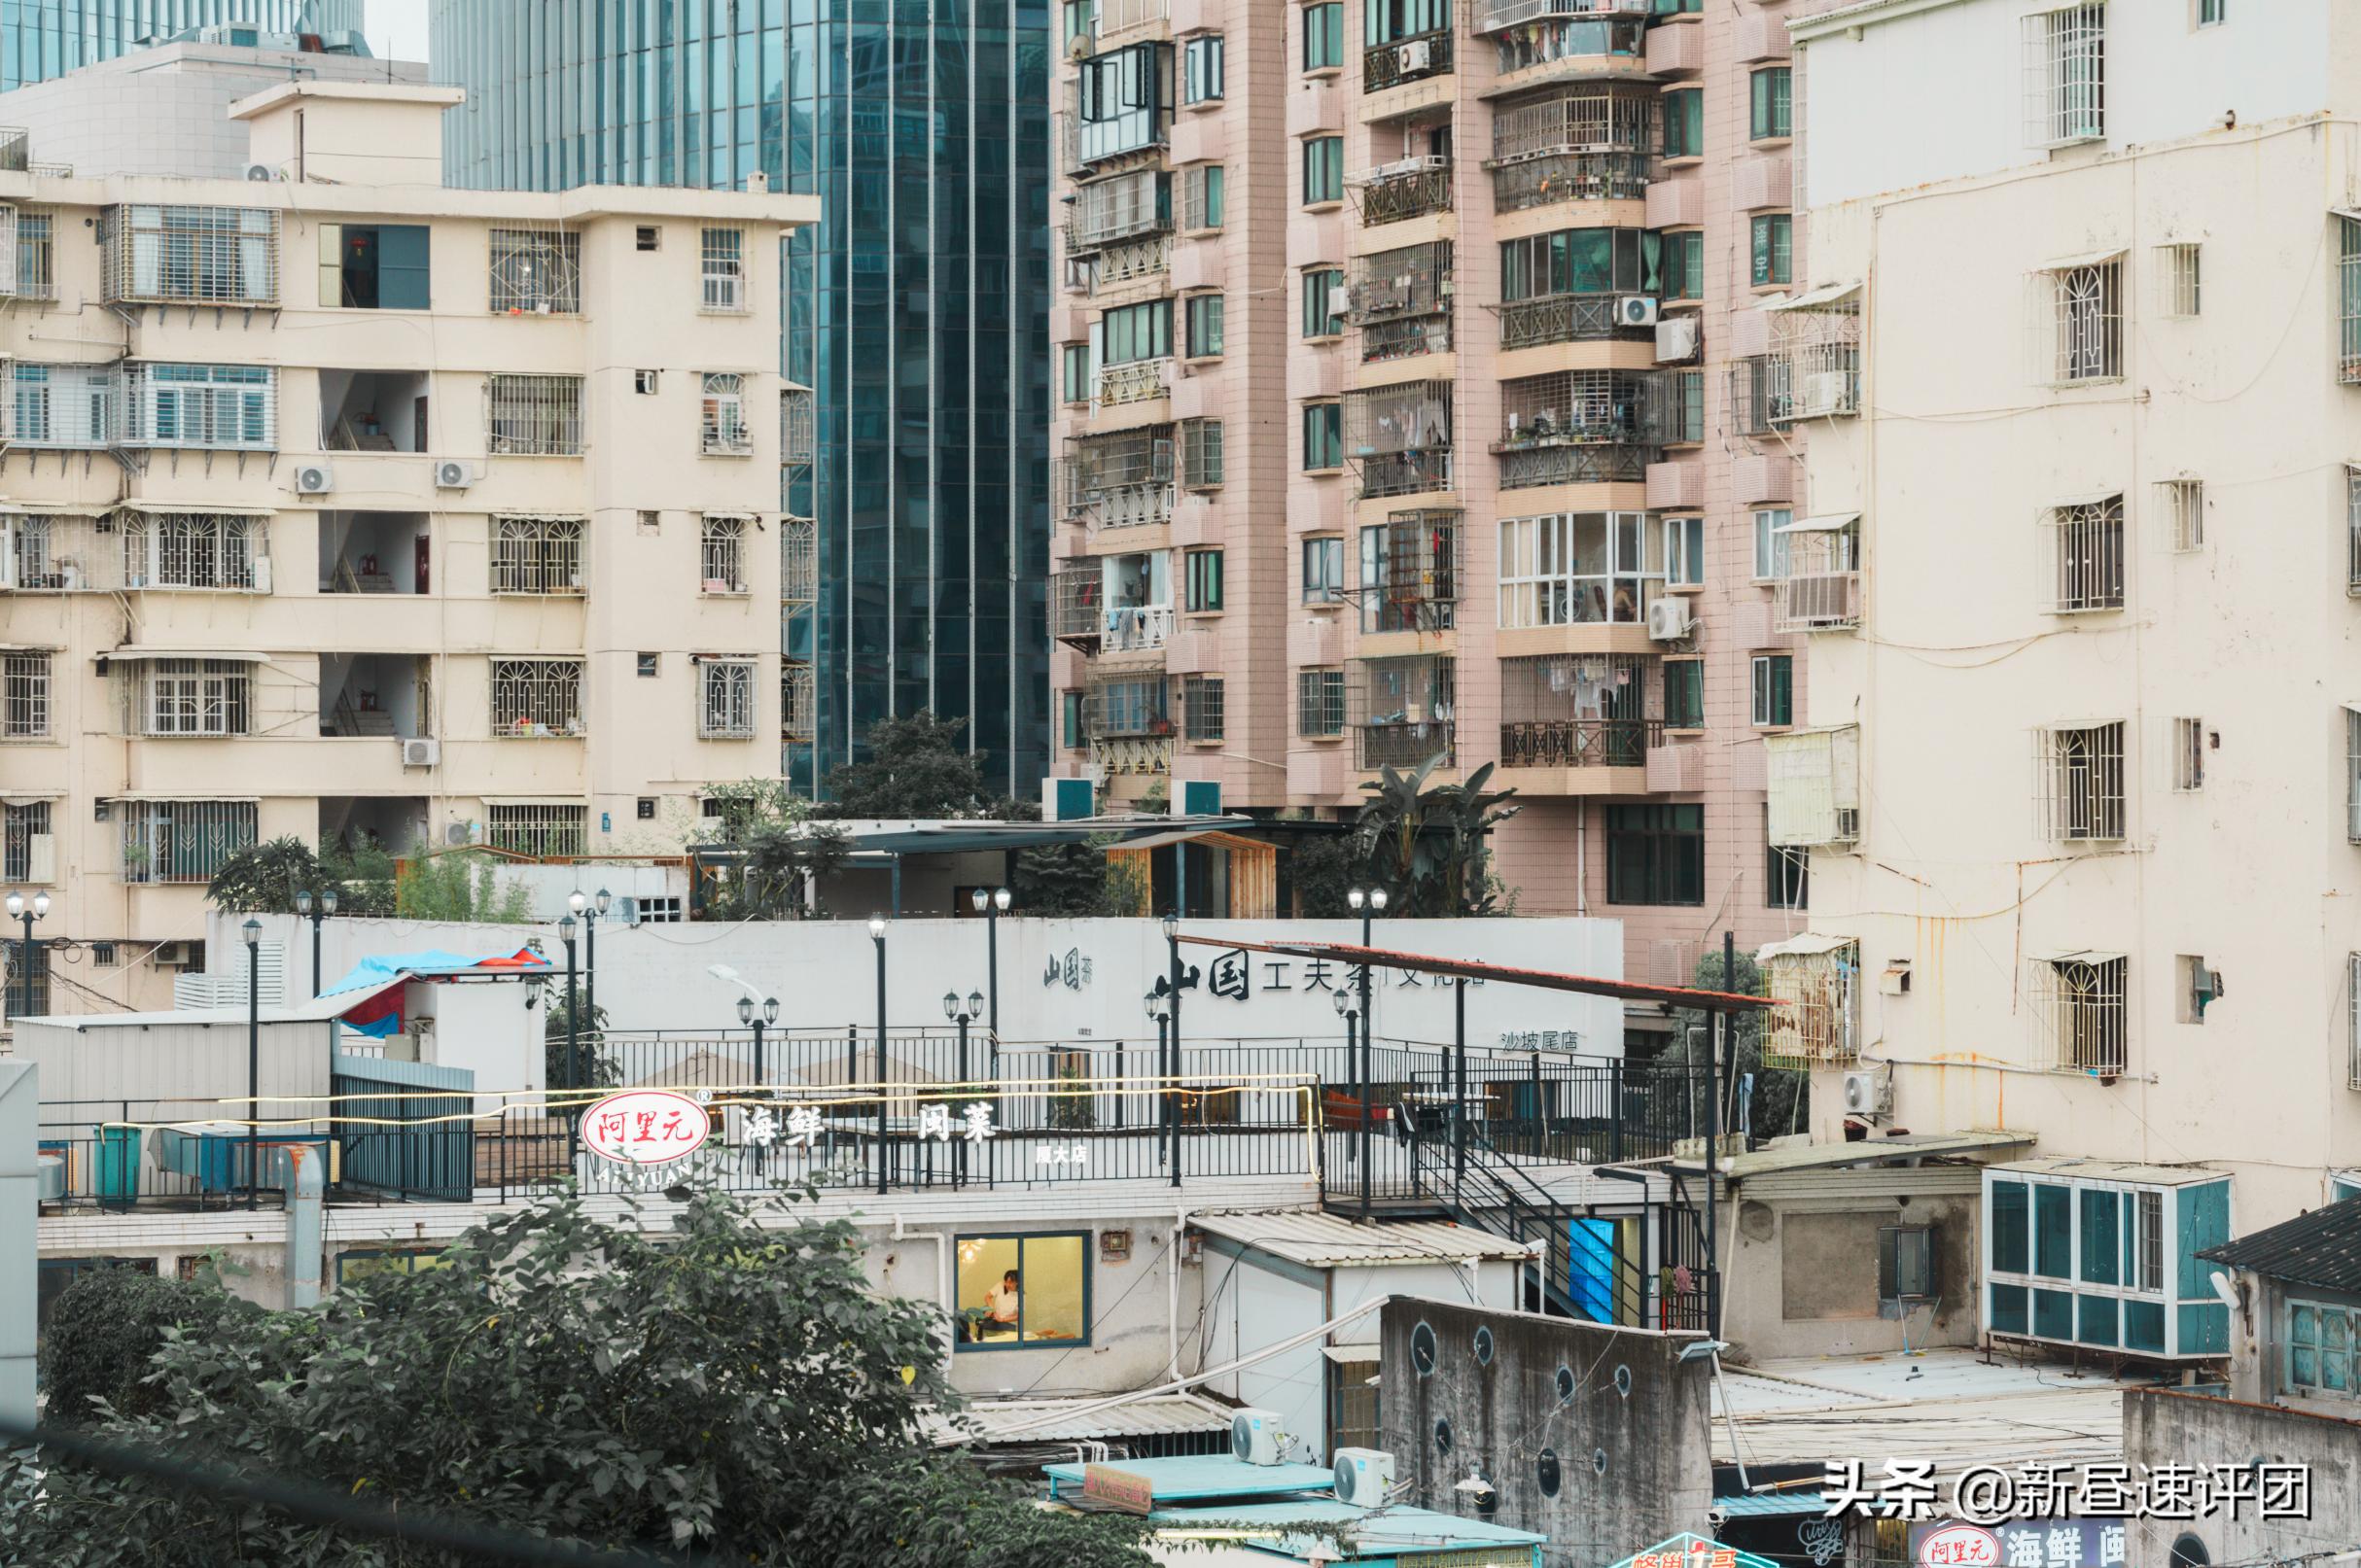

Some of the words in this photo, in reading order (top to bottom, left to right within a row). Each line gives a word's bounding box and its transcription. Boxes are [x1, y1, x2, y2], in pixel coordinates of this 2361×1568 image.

[1501, 1029, 1578, 1051] 沙坡尾店
[598, 1110, 693, 1143] 阿里元
[740, 1105, 826, 1146] 海鲜
[918, 1100, 997, 1143] 闽菜
[1036, 1144, 1087, 1164] 厦大店
[1931, 1539, 1990, 1564] 阿里元
[2007, 1527, 2082, 1568] 海鲜
